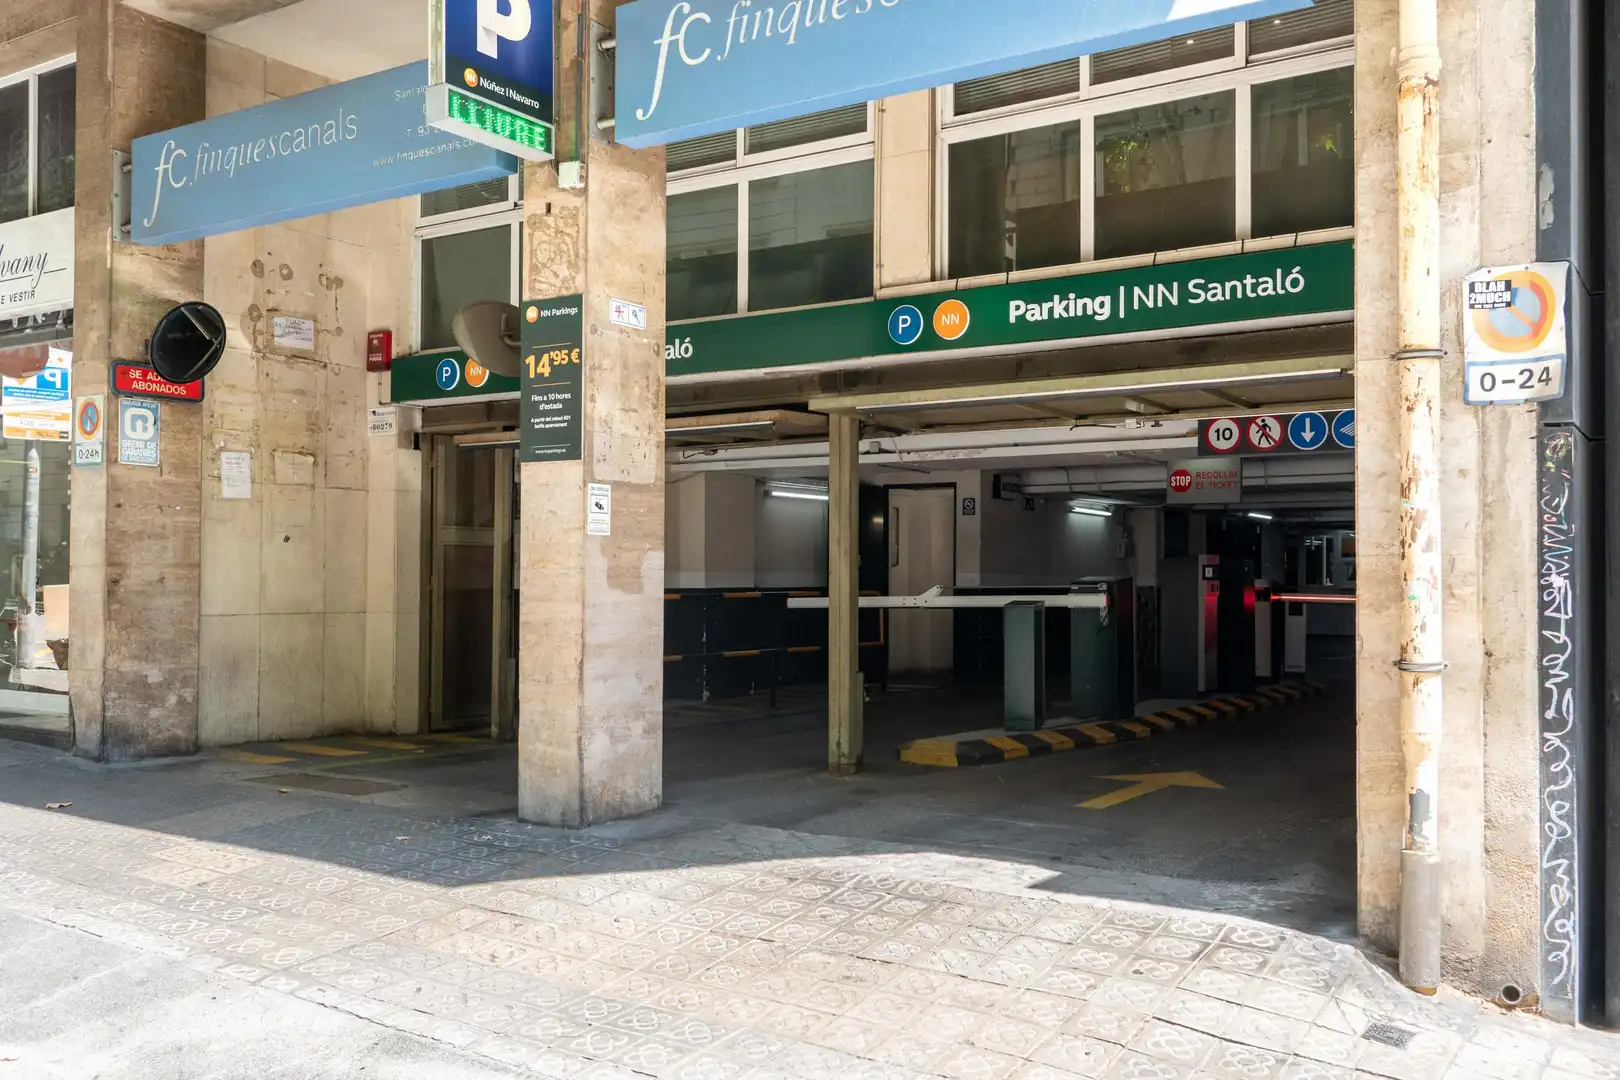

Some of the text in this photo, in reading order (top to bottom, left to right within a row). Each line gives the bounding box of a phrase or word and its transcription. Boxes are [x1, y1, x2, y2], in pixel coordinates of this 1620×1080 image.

[476, 0, 532, 59] P
[479, 76, 505, 96] Núñez
[509, 90, 540, 109] Navarro
[189, 107, 358, 186] finquescanals
[9, 290, 36, 303] VESTIR
[1009, 292, 1112, 323] Parking
[1133, 281, 1178, 310] NN
[1188, 266, 1305, 304] Santaló
[1469, 290, 1511, 304] 2MUCH
[540, 306, 578, 318] NN Parkings
[941, 311, 960, 327] NN
[898, 315, 911, 335] P
[570, 348, 580, 364] €
[129, 369, 143, 379] SE
[442, 367, 451, 382] P
[469, 366, 482, 377] NN
[131, 380, 187, 396] ABONADOS
[531, 394, 543, 402] Fins
[548, 392, 556, 401] 10
[556, 392, 571, 400] hores
[539, 402, 563, 410] d'estada
[1214, 427, 1233, 441] 10
[1170, 476, 1191, 487] STOP
[1195, 470, 1238, 480] RECOLLIU
[1195, 482, 1238, 490] EL TICKET
